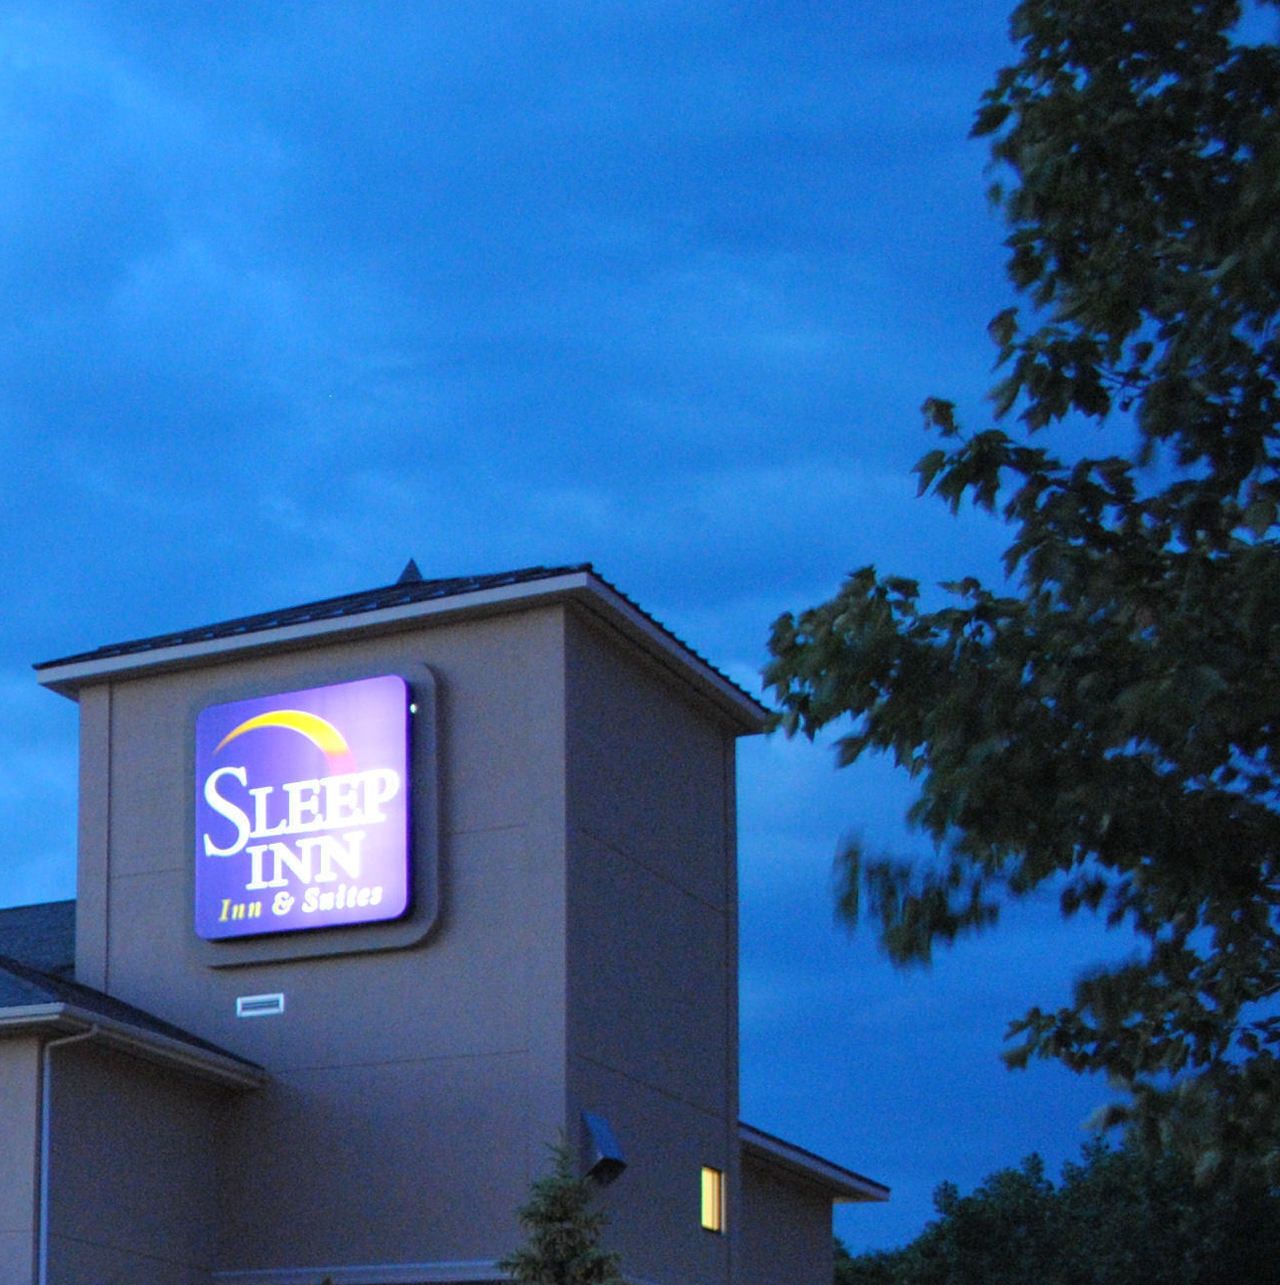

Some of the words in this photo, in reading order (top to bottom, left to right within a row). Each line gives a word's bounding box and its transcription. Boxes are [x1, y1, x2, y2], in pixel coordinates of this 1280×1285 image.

[203, 766, 400, 858] SLEEP
[245, 831, 366, 891] INN
[218, 898, 262, 922] Inn
[272, 891, 296, 916] &
[301, 884, 384, 914] Suites
